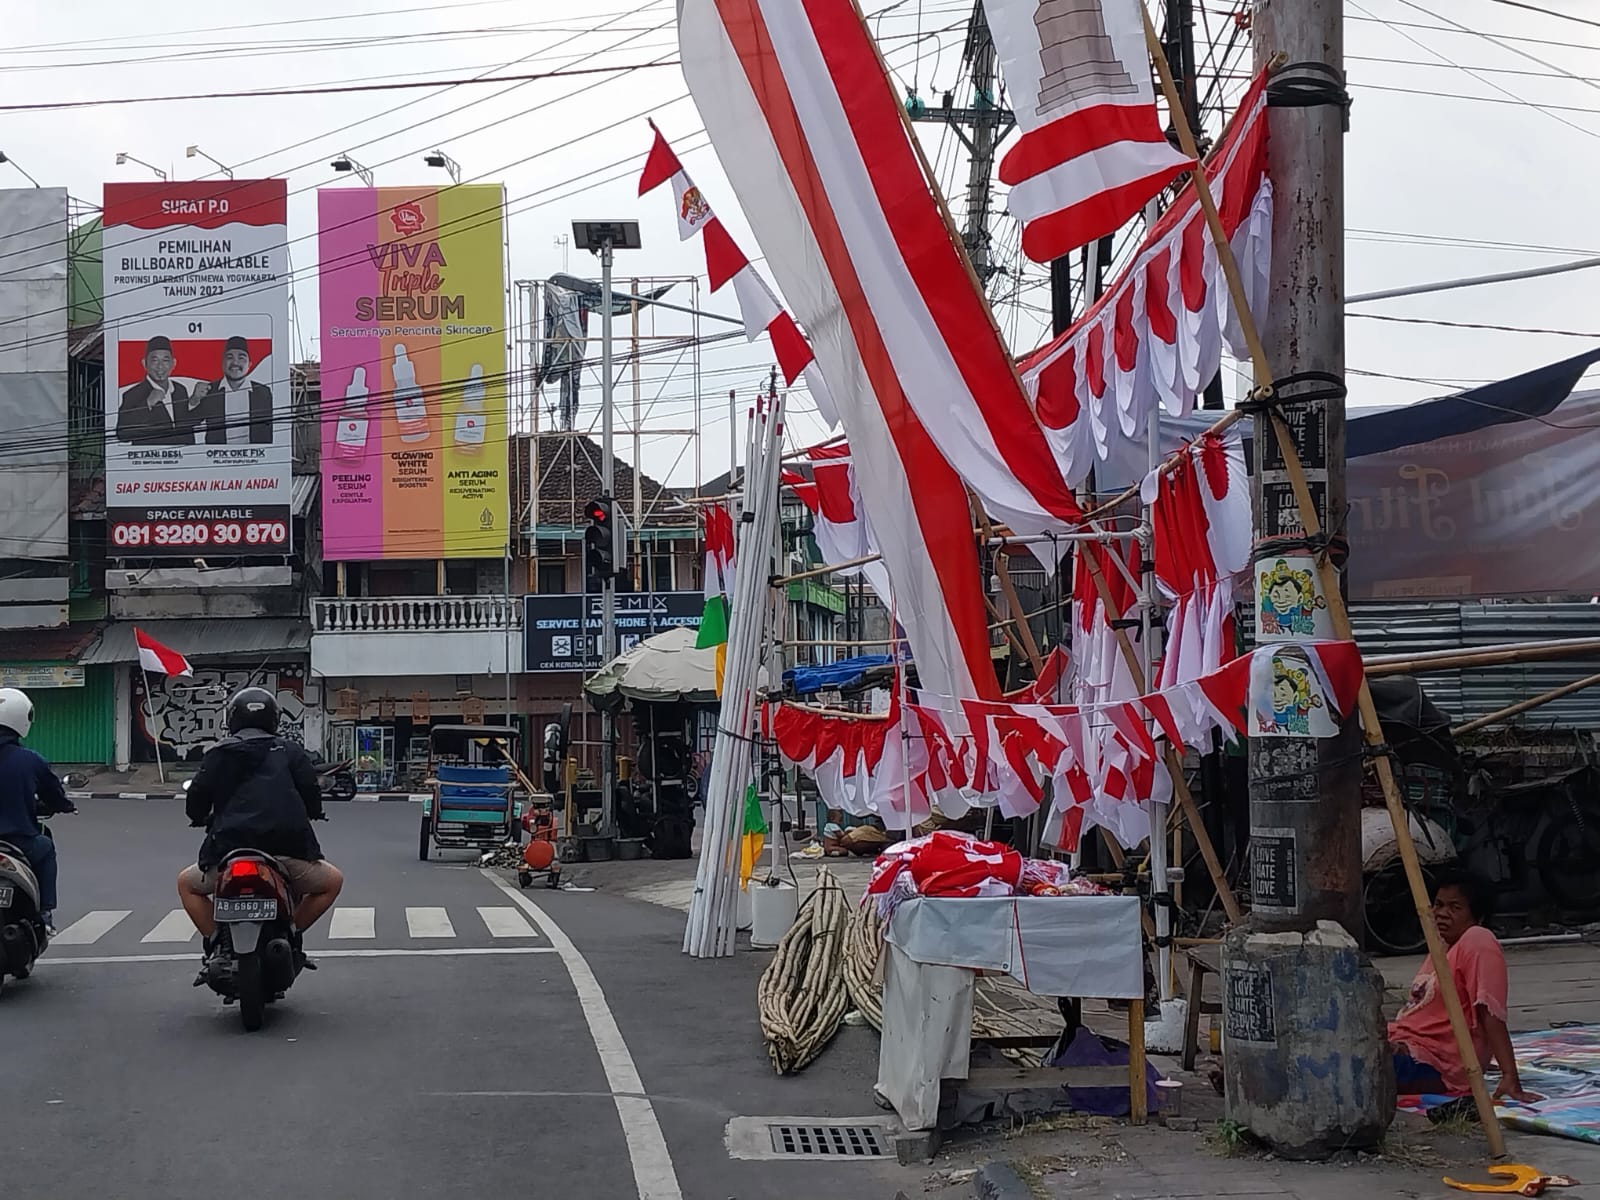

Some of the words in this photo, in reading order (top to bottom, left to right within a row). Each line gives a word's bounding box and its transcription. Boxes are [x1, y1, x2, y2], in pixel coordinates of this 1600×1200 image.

[162, 200, 205, 214] SURAT
[208, 199, 229, 214] P.O
[159, 240, 232, 254] PEMILIHAN
[366, 242, 447, 268] VIVA
[121, 257, 194, 271] BILLBOARD
[198, 255, 270, 270] AVAILABLE
[114, 275, 151, 284] PROVINSI
[152, 274, 184, 284] DAERAH
[186, 274, 224, 283] ISTIMEWA
[227, 273, 277, 283] YOGYAKARTA
[378, 263, 446, 298] Triple
[164, 286, 197, 297] TAHUN
[199, 286, 224, 297] 2023
[355, 295, 465, 322] SERUM
[188, 322, 203, 334] 01
[330, 327, 391, 338] Serum-nya
[394, 326, 442, 336] Pencinta
[445, 325, 493, 336] Skincare
[230, 449, 249, 458] OKE
[250, 448, 266, 458] FIX
[391, 452, 434, 460] GLOWING
[398, 460, 428, 468] WHITE
[331, 474, 373, 482] PEELING
[398, 468, 428, 476] SERUM
[447, 471, 470, 479] ANTI
[471, 470, 499, 478] AGING
[115, 483, 141, 495] SIAP
[143, 480, 207, 494] SUKSESKAN
[210, 479, 243, 492] IKLAN
[245, 478, 279, 491] ANDA!
[337, 482, 367, 490] SERUM
[459, 479, 487, 487] SERUM
[146, 510, 185, 521] SPACE
[187, 509, 253, 520] AVAILABLE
[113, 524, 150, 545] 081
[154, 524, 209, 545] 3280
[213, 523, 241, 544] 30
[245, 522, 286, 543] 870
[591, 596, 668, 610] REMIX
[536, 619, 579, 630] SERVICE
[581, 617, 647, 629] HANPHONE
[1256, 847, 1276, 863] LOVE
[1256, 864, 1276, 879] HATE
[1256, 879, 1276, 896] LOVE
[217, 901, 229, 911] AB
[1234, 980, 1254, 997] LOVE
[1234, 997, 1256, 1014] HATE
